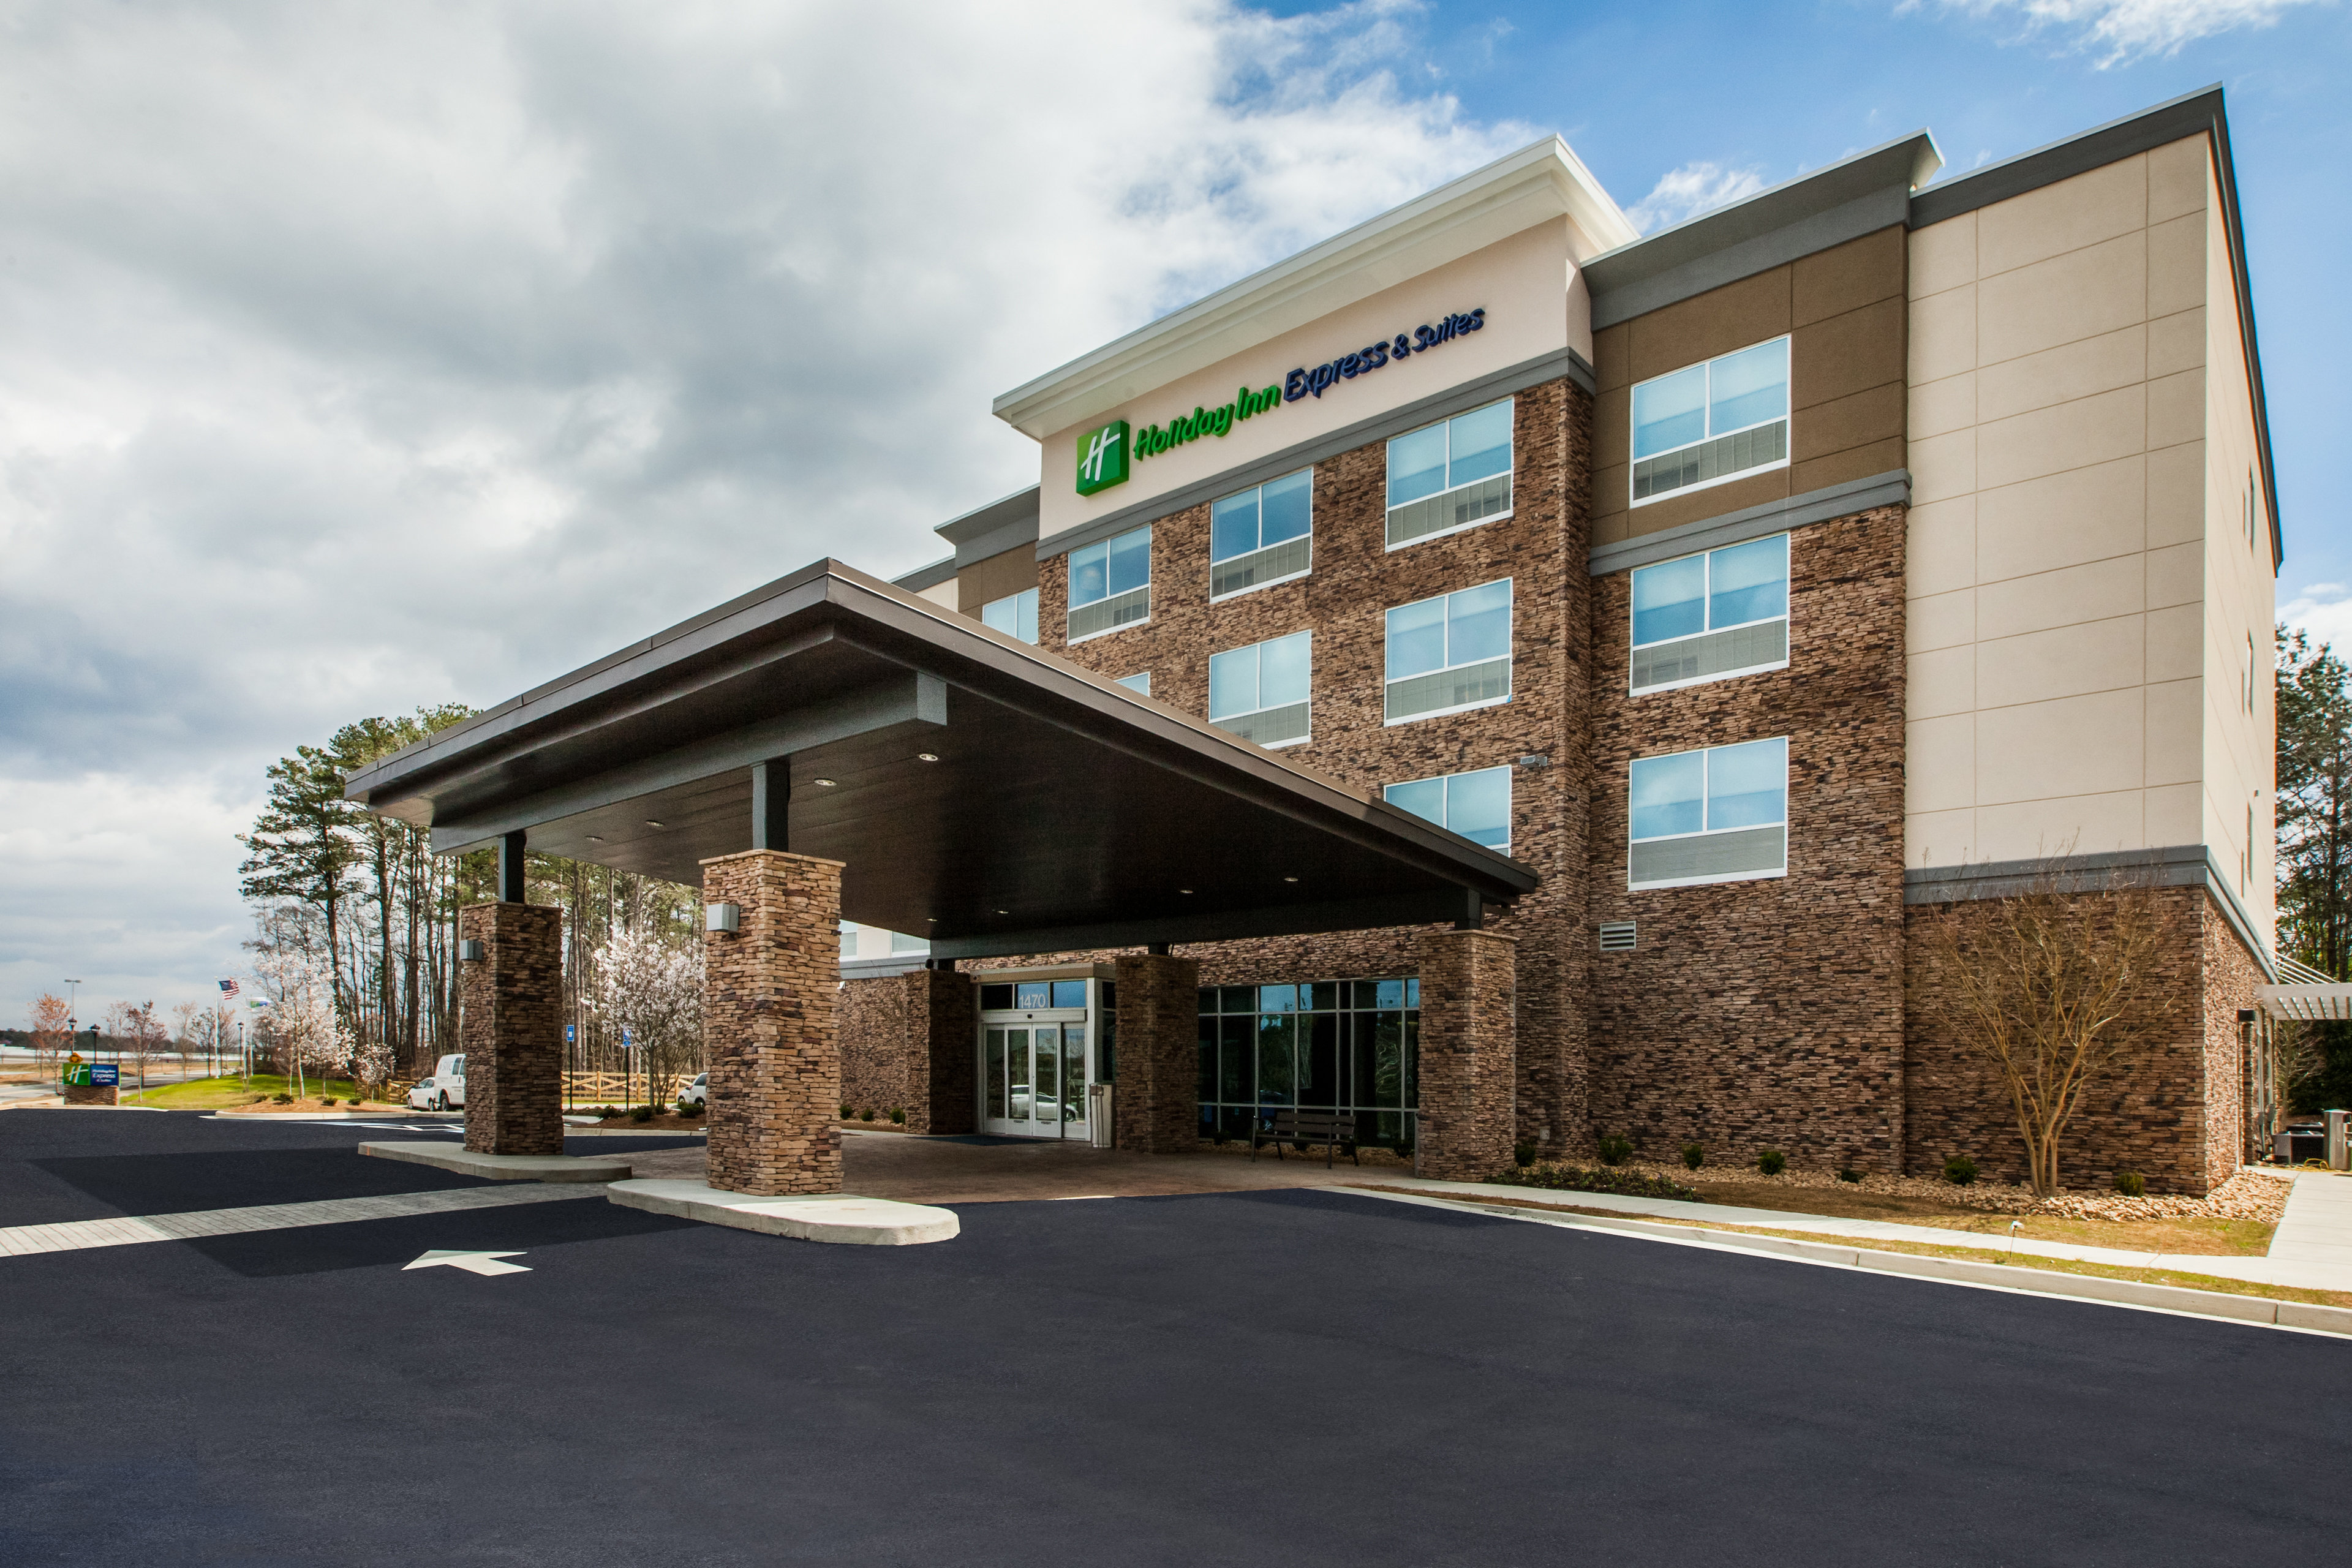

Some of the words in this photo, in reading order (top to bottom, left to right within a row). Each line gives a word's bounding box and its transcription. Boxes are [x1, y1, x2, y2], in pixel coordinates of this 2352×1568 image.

[1133, 403, 1235, 462] Holiday
[1235, 385, 1282, 421] Inn
[1283, 341, 1389, 402] Express
[1391, 333, 1411, 360] &
[1412, 308, 1485, 353] Suites
[1019, 993, 1046, 1009] 1470
